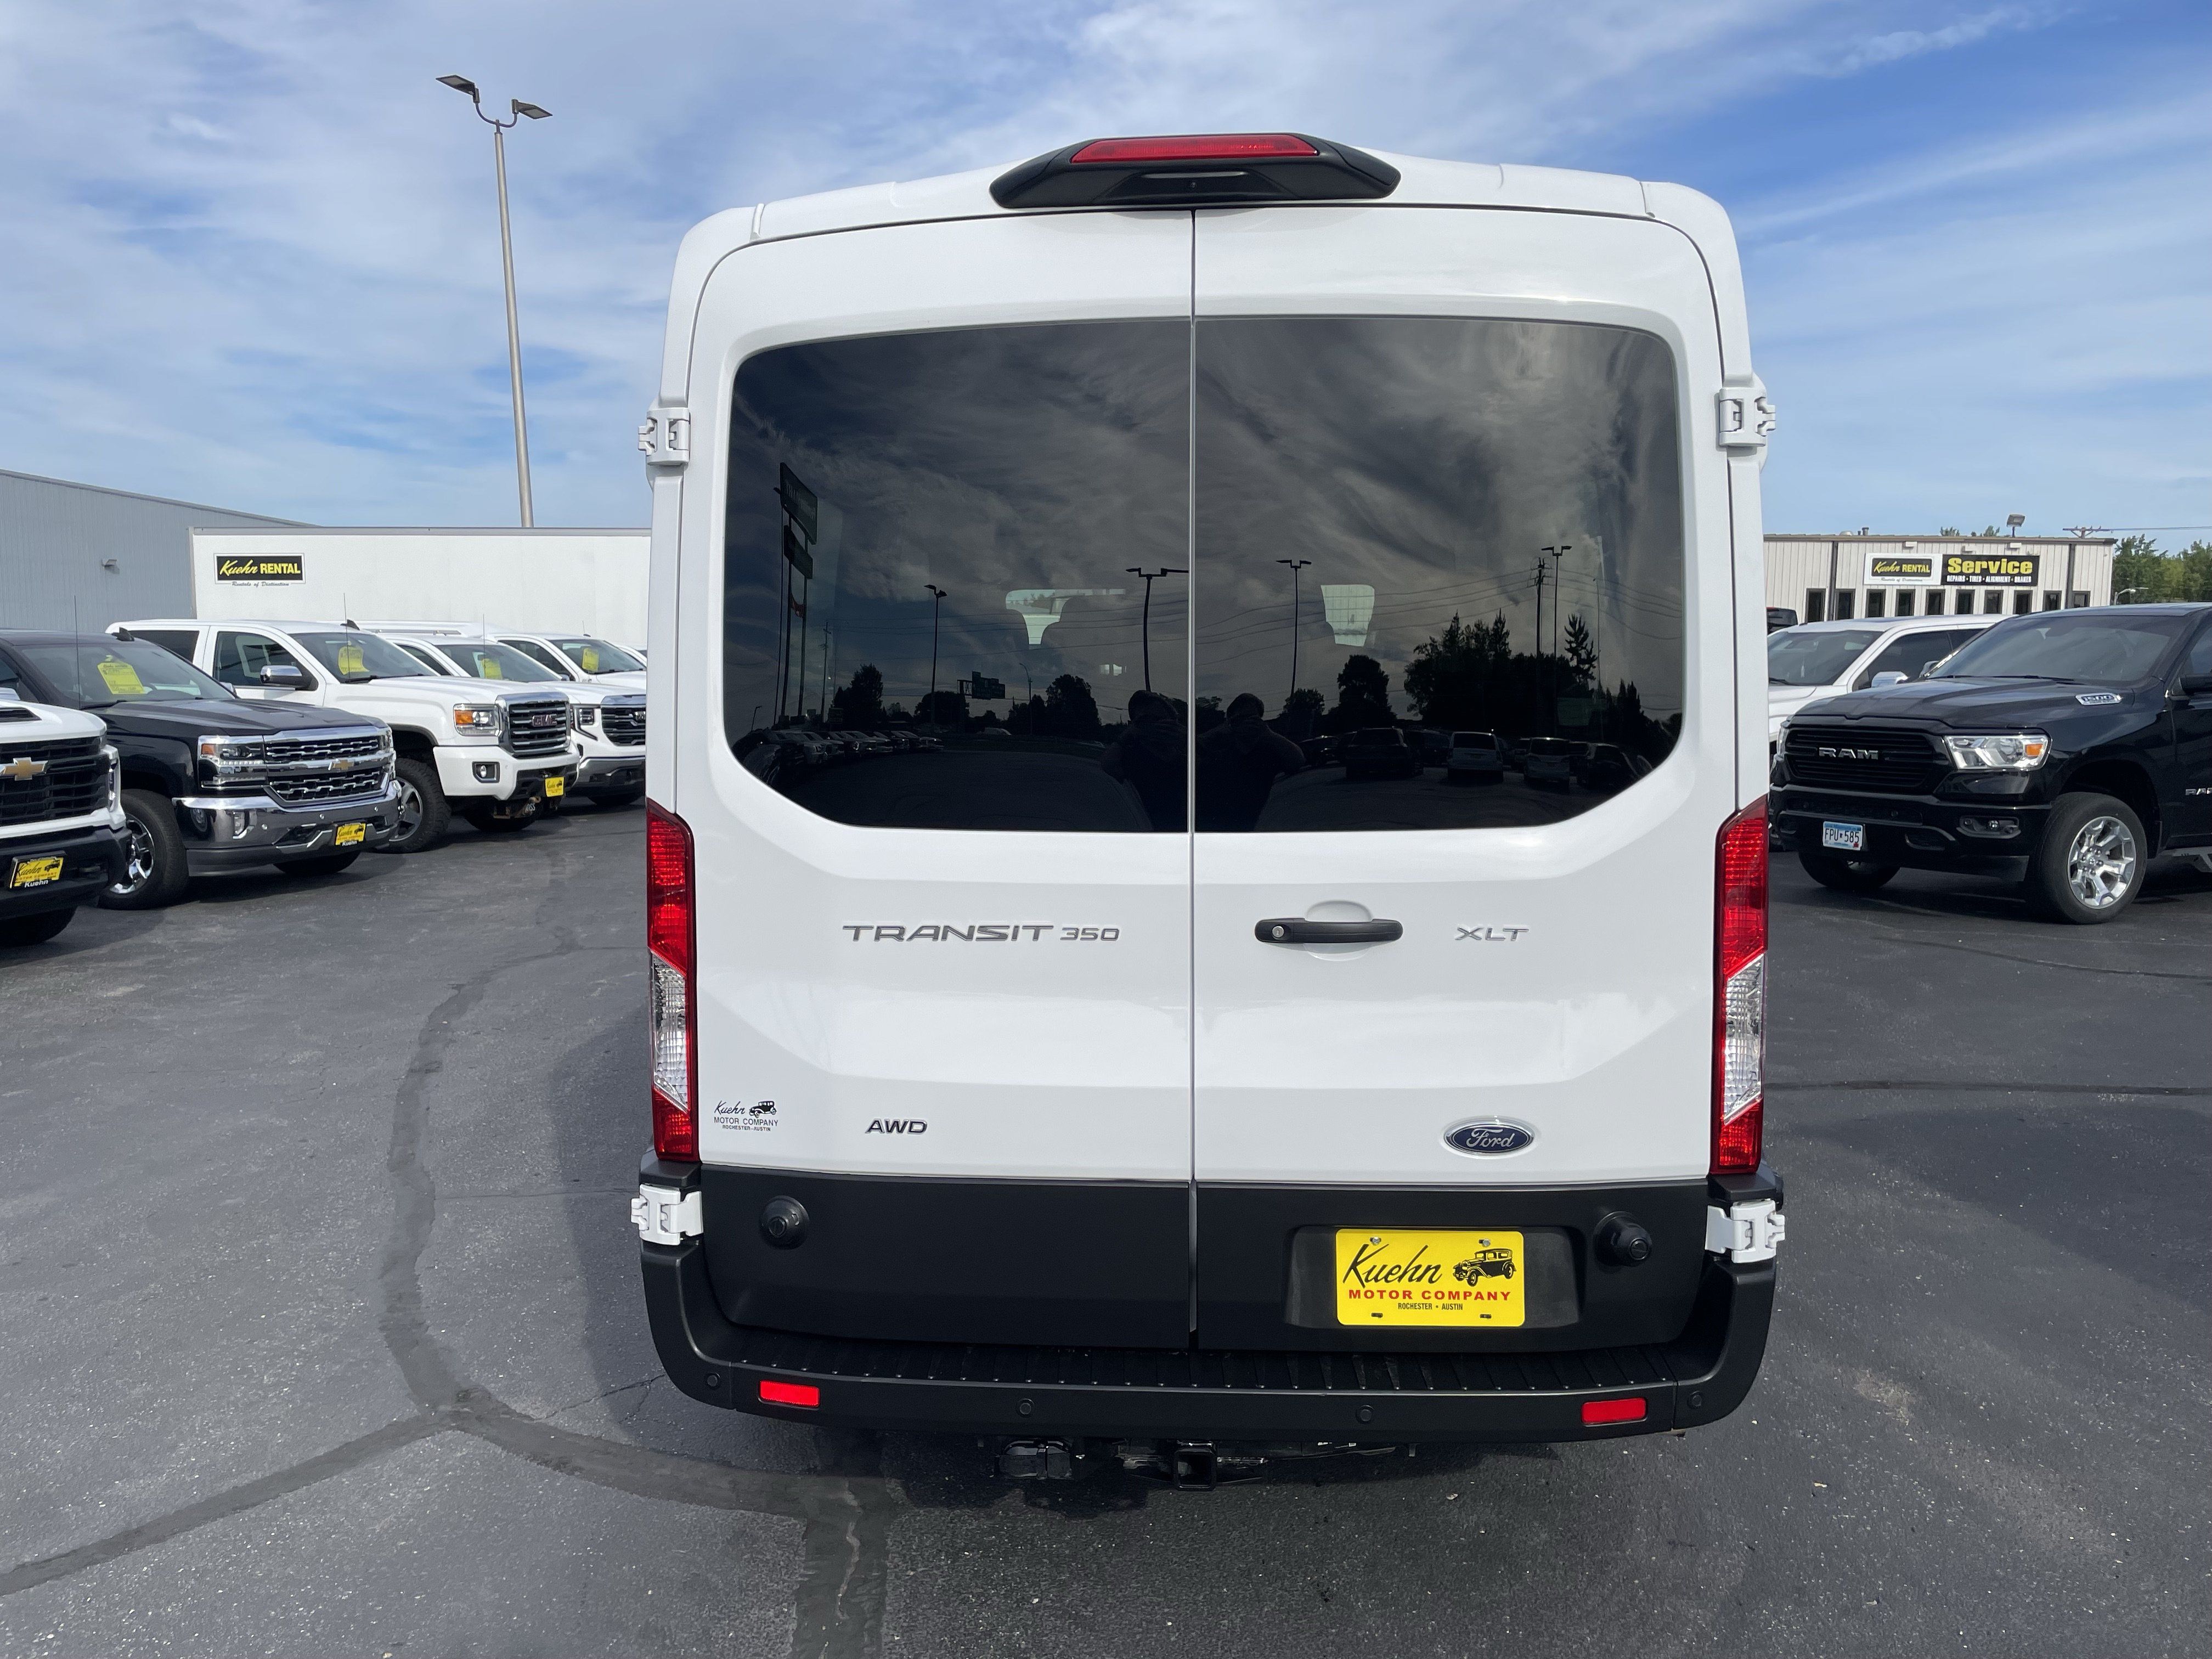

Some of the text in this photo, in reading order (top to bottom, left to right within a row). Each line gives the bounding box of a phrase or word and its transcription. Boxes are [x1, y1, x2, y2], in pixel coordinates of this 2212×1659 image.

[219, 559, 301, 577] Kuehn RENTAL
[1874, 561, 1930, 573] Kuehn RENTAL
[1948, 557, 2033, 574] Service
[532, 714, 557, 727] GMC
[1819, 747, 1878, 760] RAM
[1825, 828, 1859, 843] FPU 585
[24, 879, 48, 888] Kuehn
[842, 925, 1121, 942] TRANSIT 350
[1454, 926, 1530, 941] XLT
[714, 1101, 746, 1115] Kuehn
[714, 1116, 778, 1127] MOTOR COMPANY
[865, 1118, 928, 1135] AWD
[1466, 1128, 1515, 1148] Ford
[1342, 1244, 1443, 1289] Kuehn
[1348, 1289, 1511, 1301] MOTOR COMPANY
